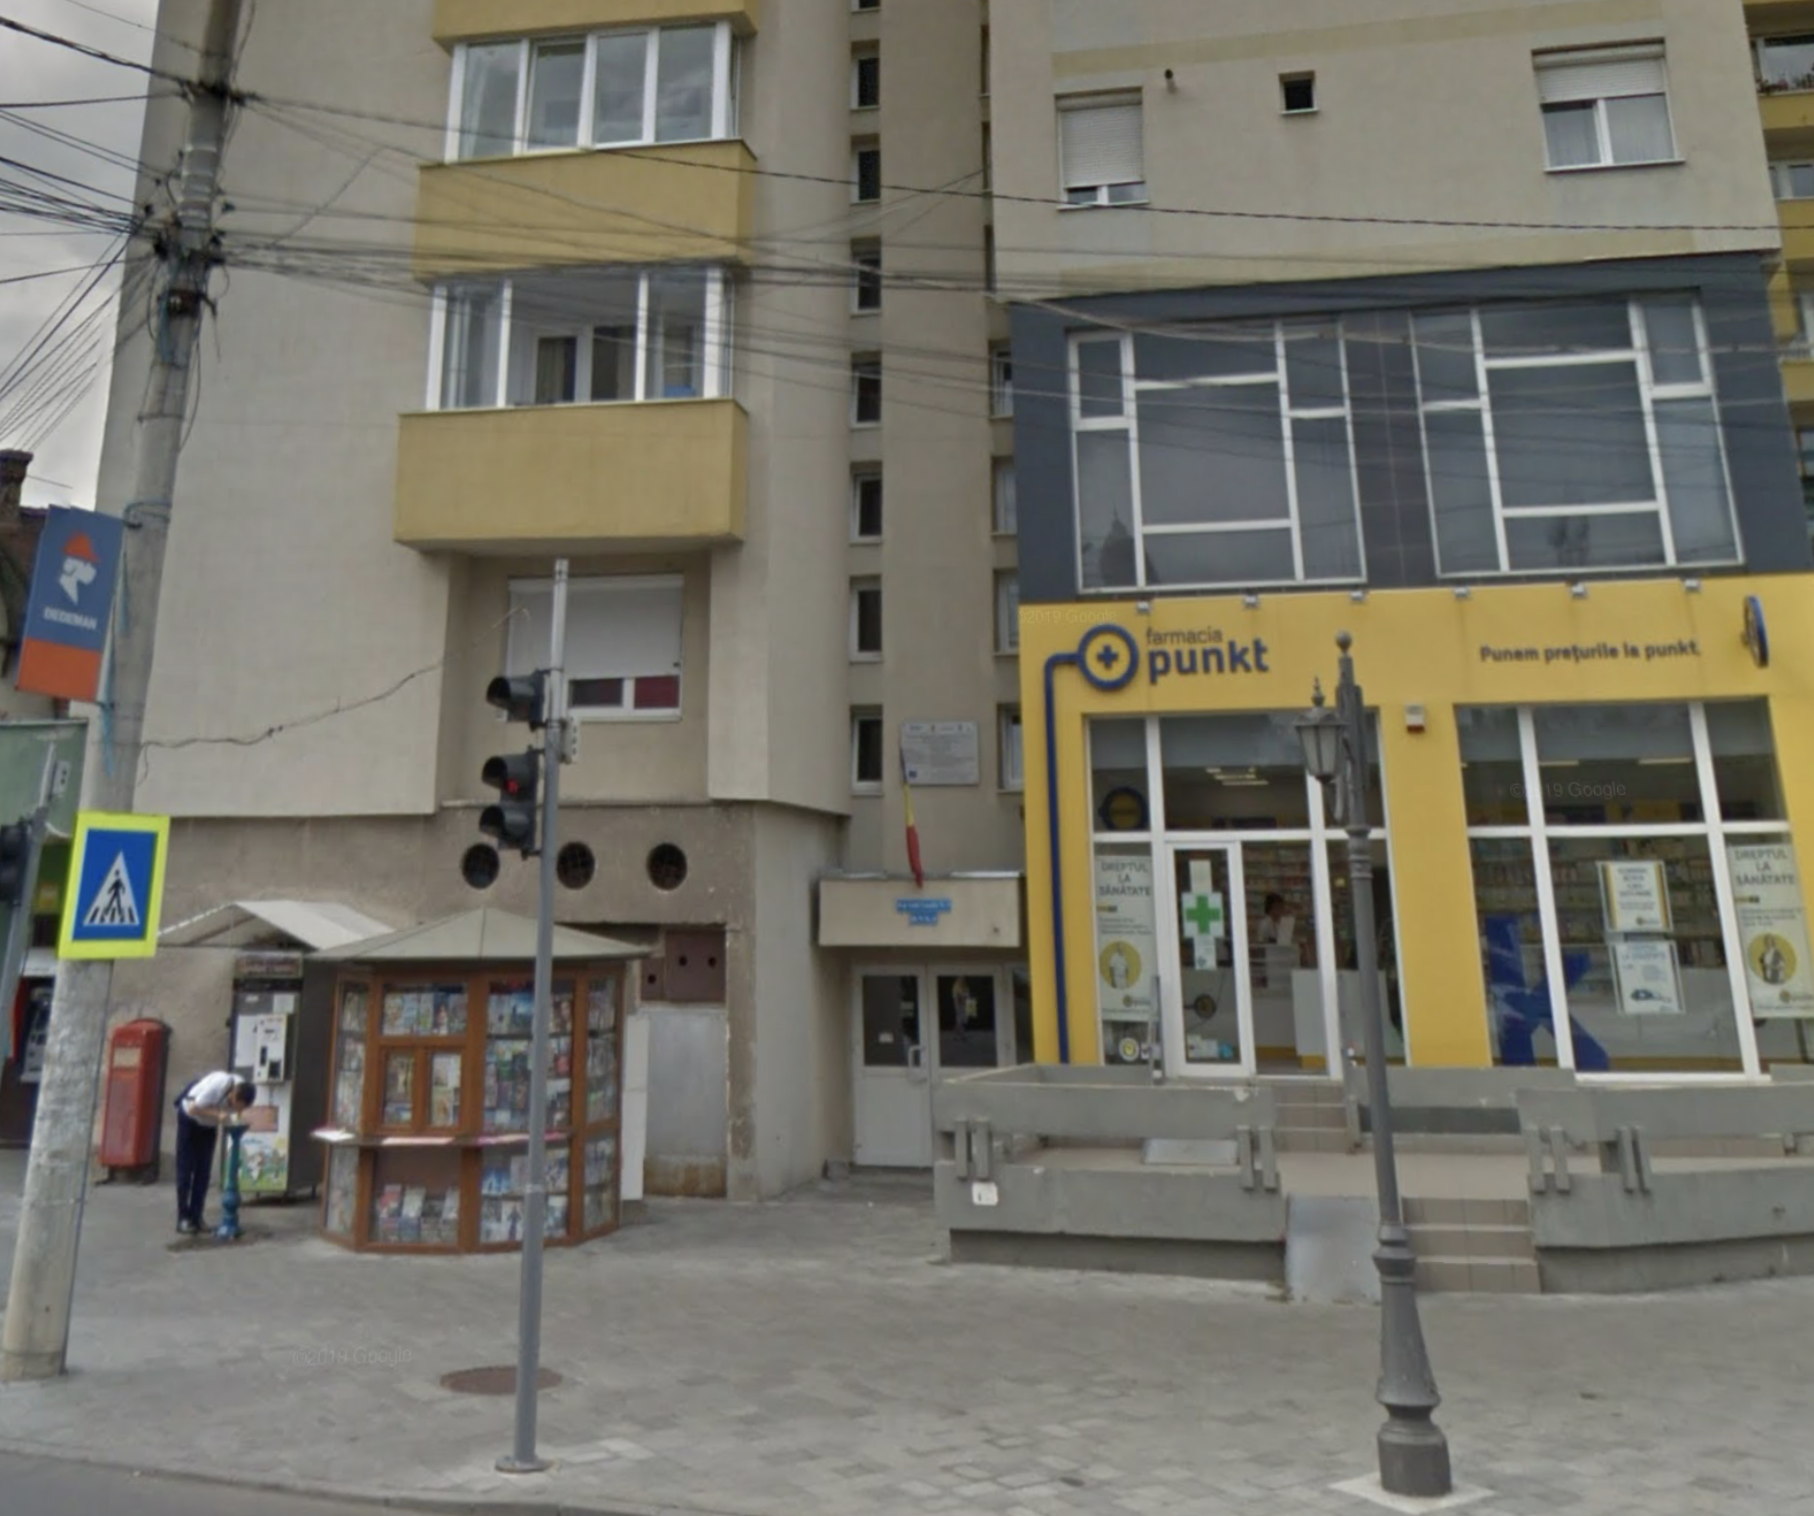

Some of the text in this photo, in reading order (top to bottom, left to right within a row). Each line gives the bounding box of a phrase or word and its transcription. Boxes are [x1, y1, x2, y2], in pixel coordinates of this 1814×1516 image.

[43, 607, 97, 630] DEDEMAN
[1146, 626, 1223, 646] farmacia
[1149, 638, 1269, 684] punkt
[1480, 644, 1539, 662] Punem
[1623, 641, 1640, 659] la
[1101, 861, 1148, 872] DREPTUL
[1756, 861, 1771, 872] LA
[1118, 874, 1131, 884] LA
